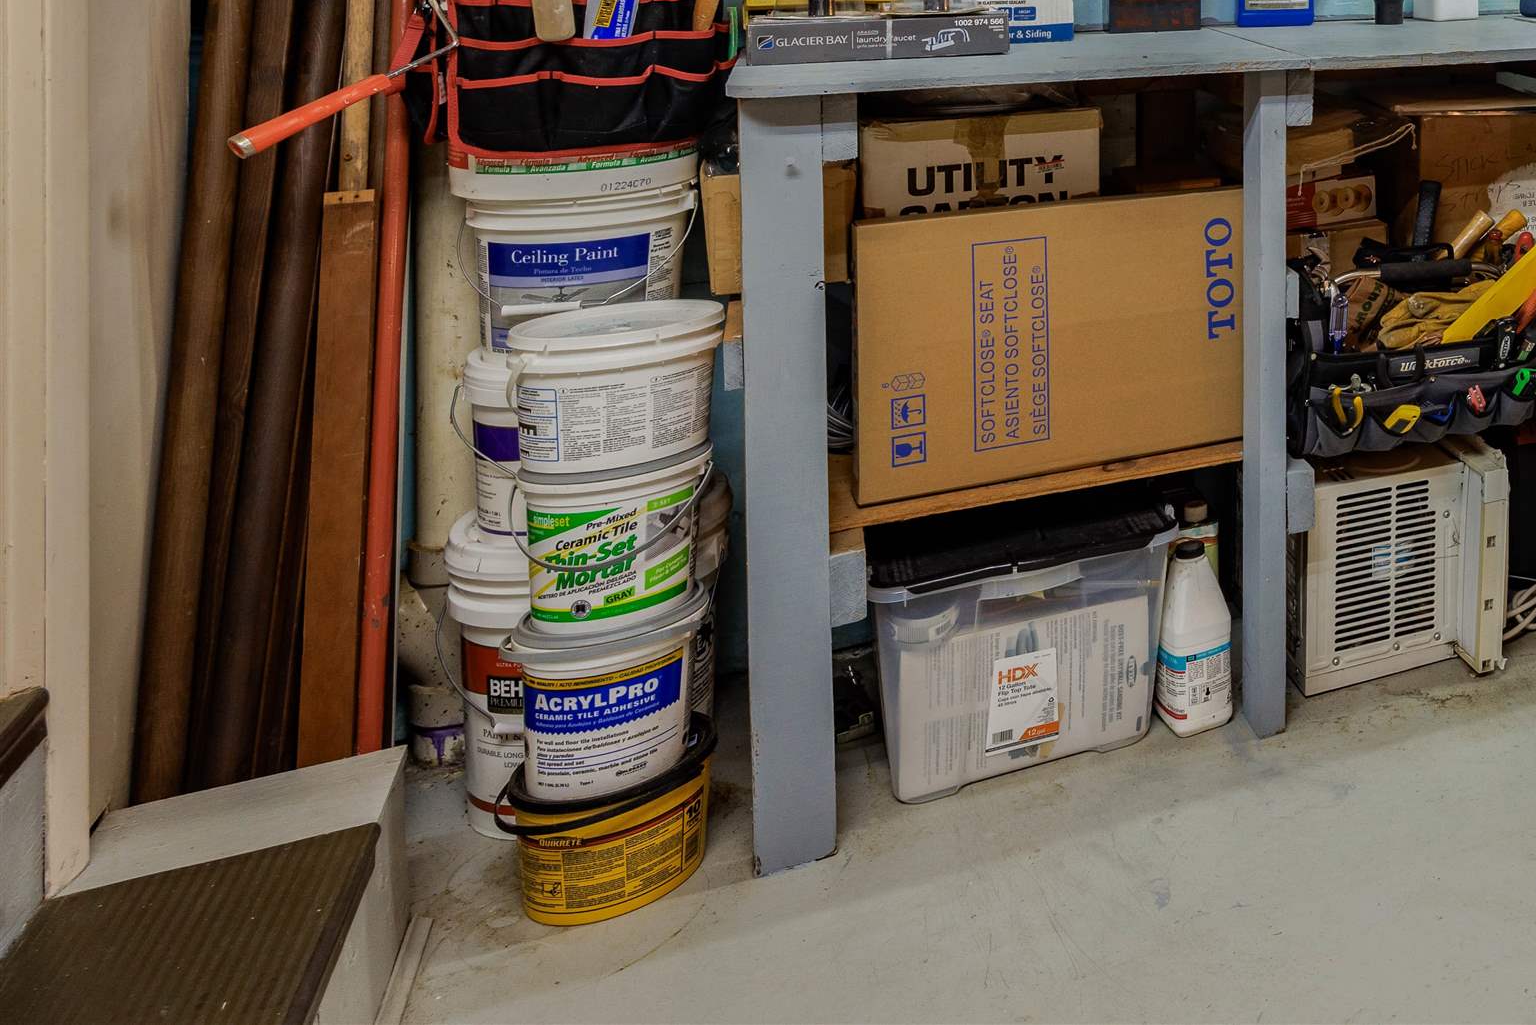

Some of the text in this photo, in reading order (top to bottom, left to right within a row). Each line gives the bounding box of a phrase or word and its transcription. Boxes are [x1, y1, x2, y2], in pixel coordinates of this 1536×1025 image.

[776, 35, 848, 47] GLACIER BAY
[856, 35, 888, 44] laundry
[1028, 30, 1051, 39] Siding
[530, 164, 567, 173] Avanzada
[907, 154, 1065, 197] UTILITY
[511, 246, 619, 266] Ceiling Paint
[1204, 217, 1235, 339] TOTO
[979, 280, 995, 325] SEAT
[1005, 357, 1019, 439] ASIENTO
[585, 507, 637, 531] Pre-Mixed
[555, 520, 638, 551] Ceramic Tile
[545, 533, 638, 573] Thin-Set
[606, 588, 633, 604] GRAY
[998, 663, 1038, 685] HDX
[490, 678, 523, 698] BEH
[535, 694, 656, 720] CERAMIC TILE ADHESIVE
[539, 838, 582, 847] QUIKRETE
